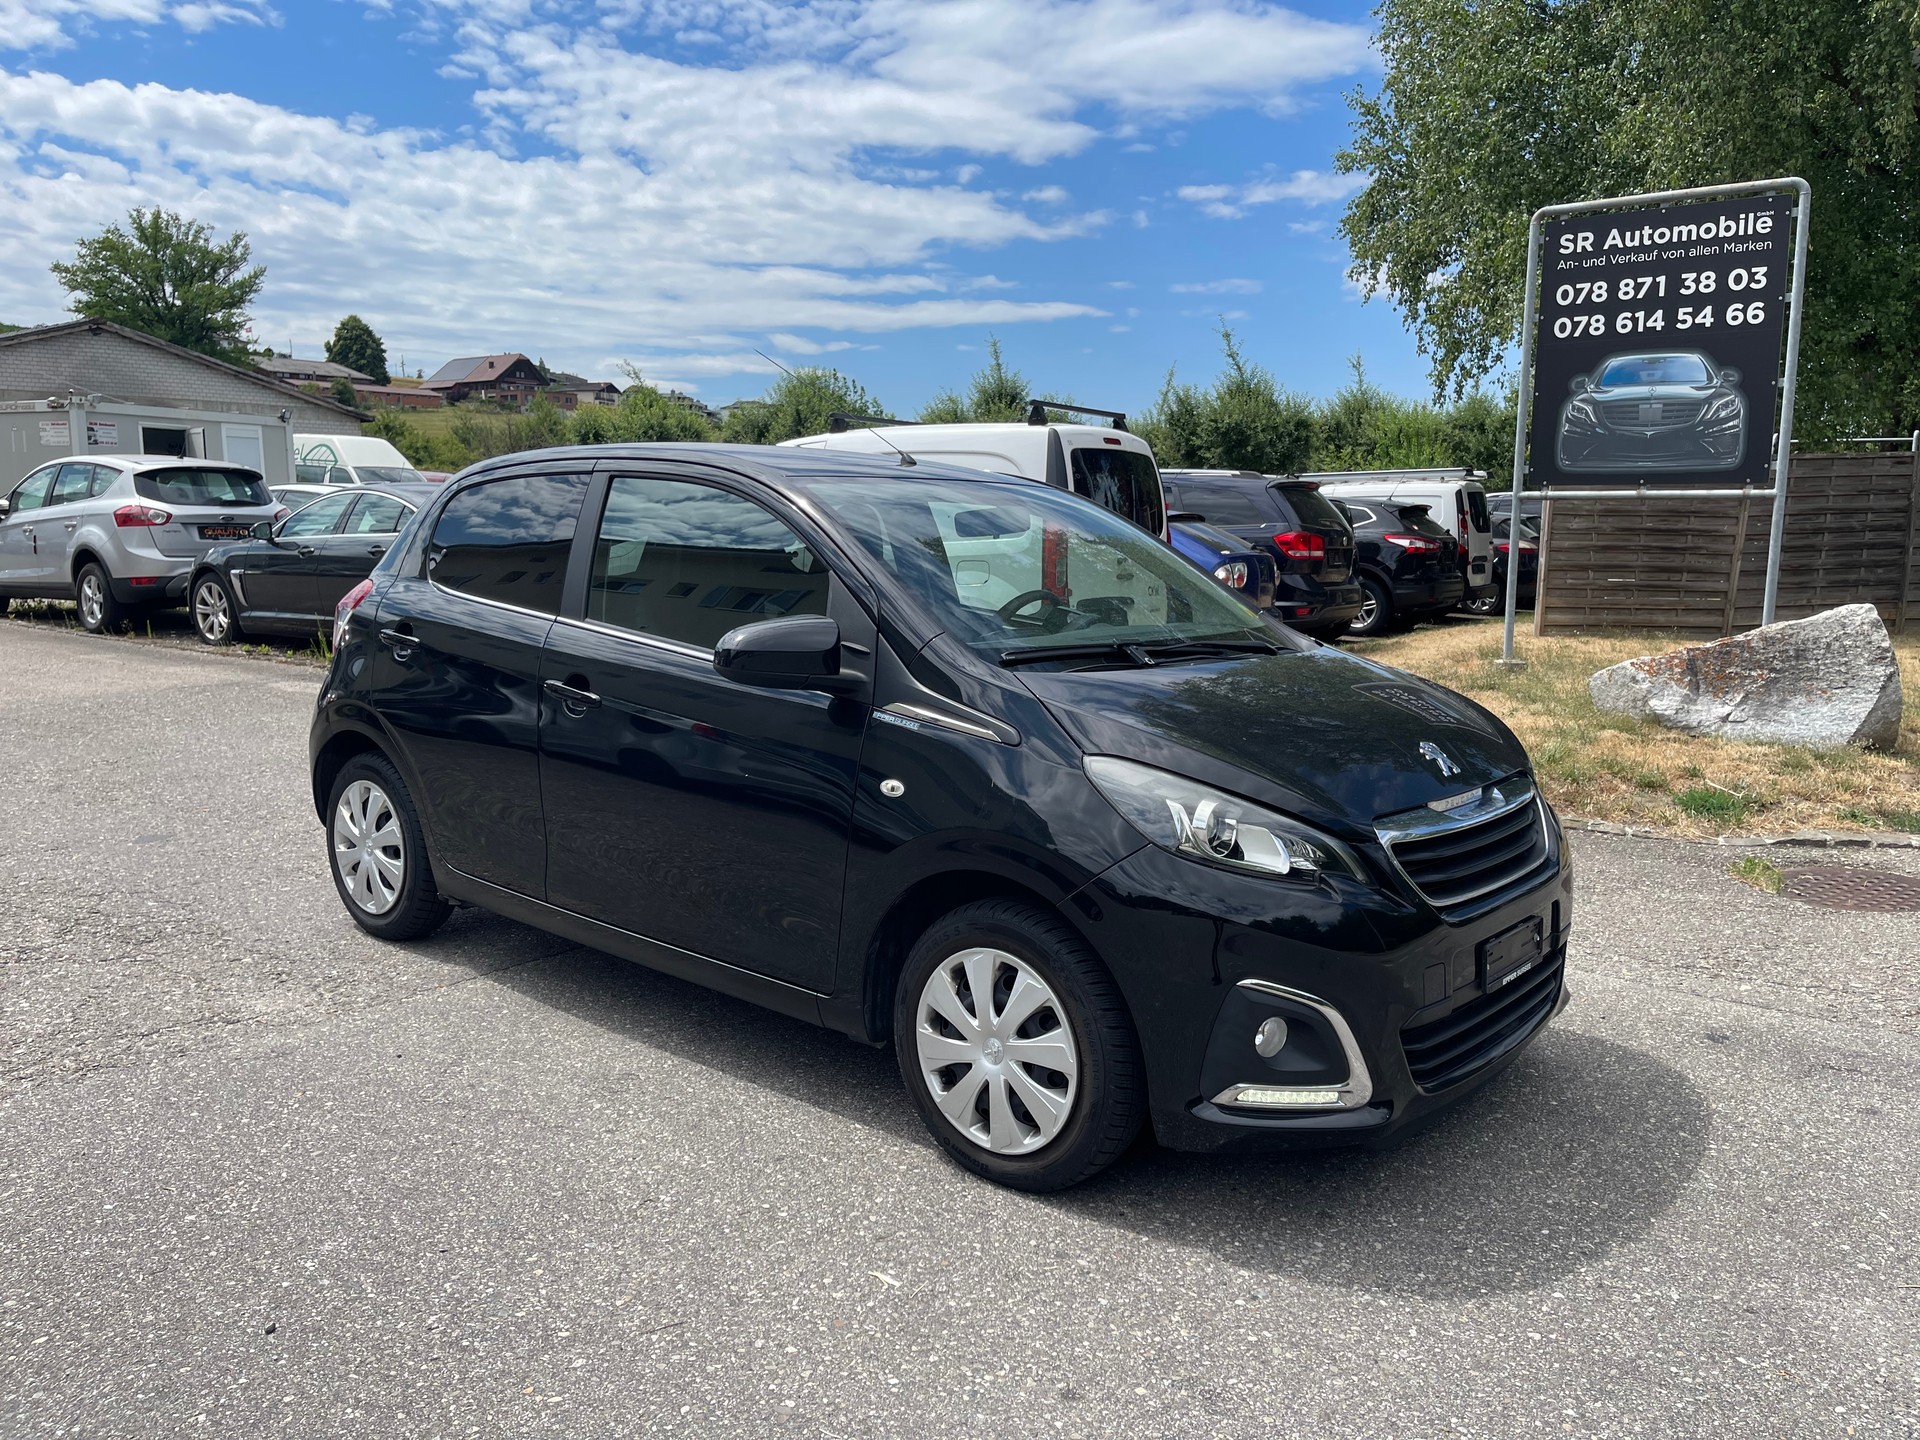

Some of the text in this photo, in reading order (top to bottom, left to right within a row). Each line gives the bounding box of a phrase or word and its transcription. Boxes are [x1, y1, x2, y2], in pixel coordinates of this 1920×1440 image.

[1558, 213, 1774, 255] SR Automobile
[1557, 239, 1773, 270] An- und Verkauf von allen Marken
[1555, 266, 1768, 306] 078 871 38 03
[1553, 301, 1765, 339] 078 614 54 66
